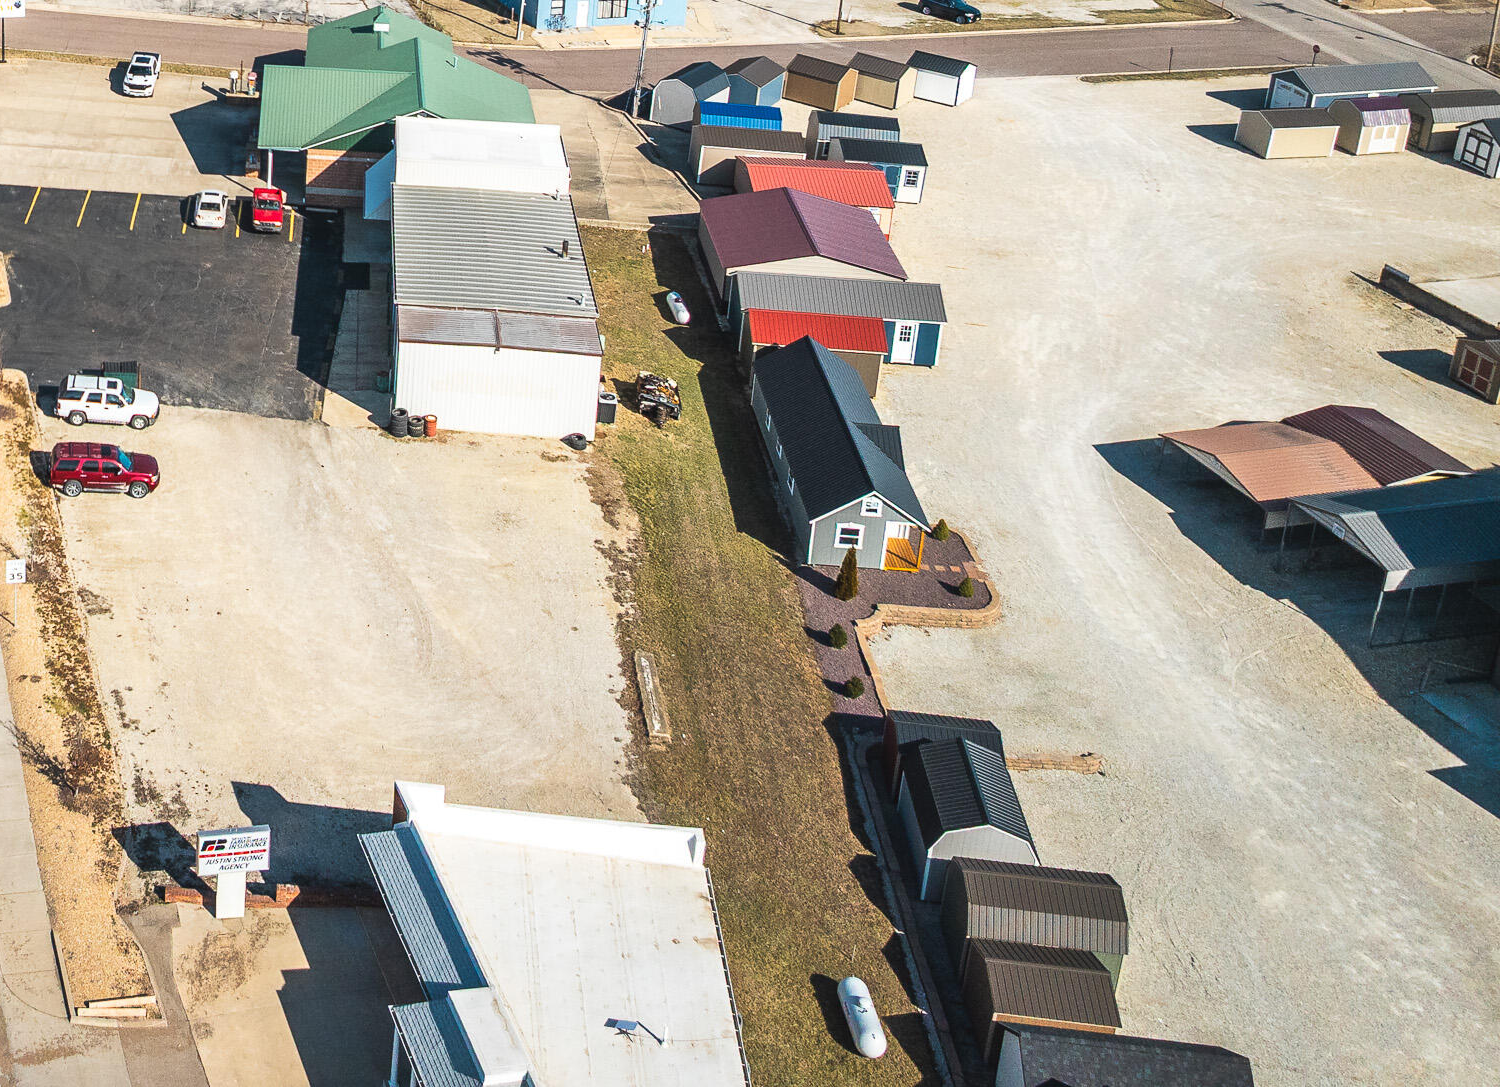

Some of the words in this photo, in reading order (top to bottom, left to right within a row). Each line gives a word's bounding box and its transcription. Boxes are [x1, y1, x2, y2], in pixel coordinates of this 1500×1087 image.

[229, 841, 267, 850] INSURANCE
[205, 857, 231, 865] JUSTIN
[233, 854, 264, 862] STRONG
[219, 862, 250, 871] AGENCY
